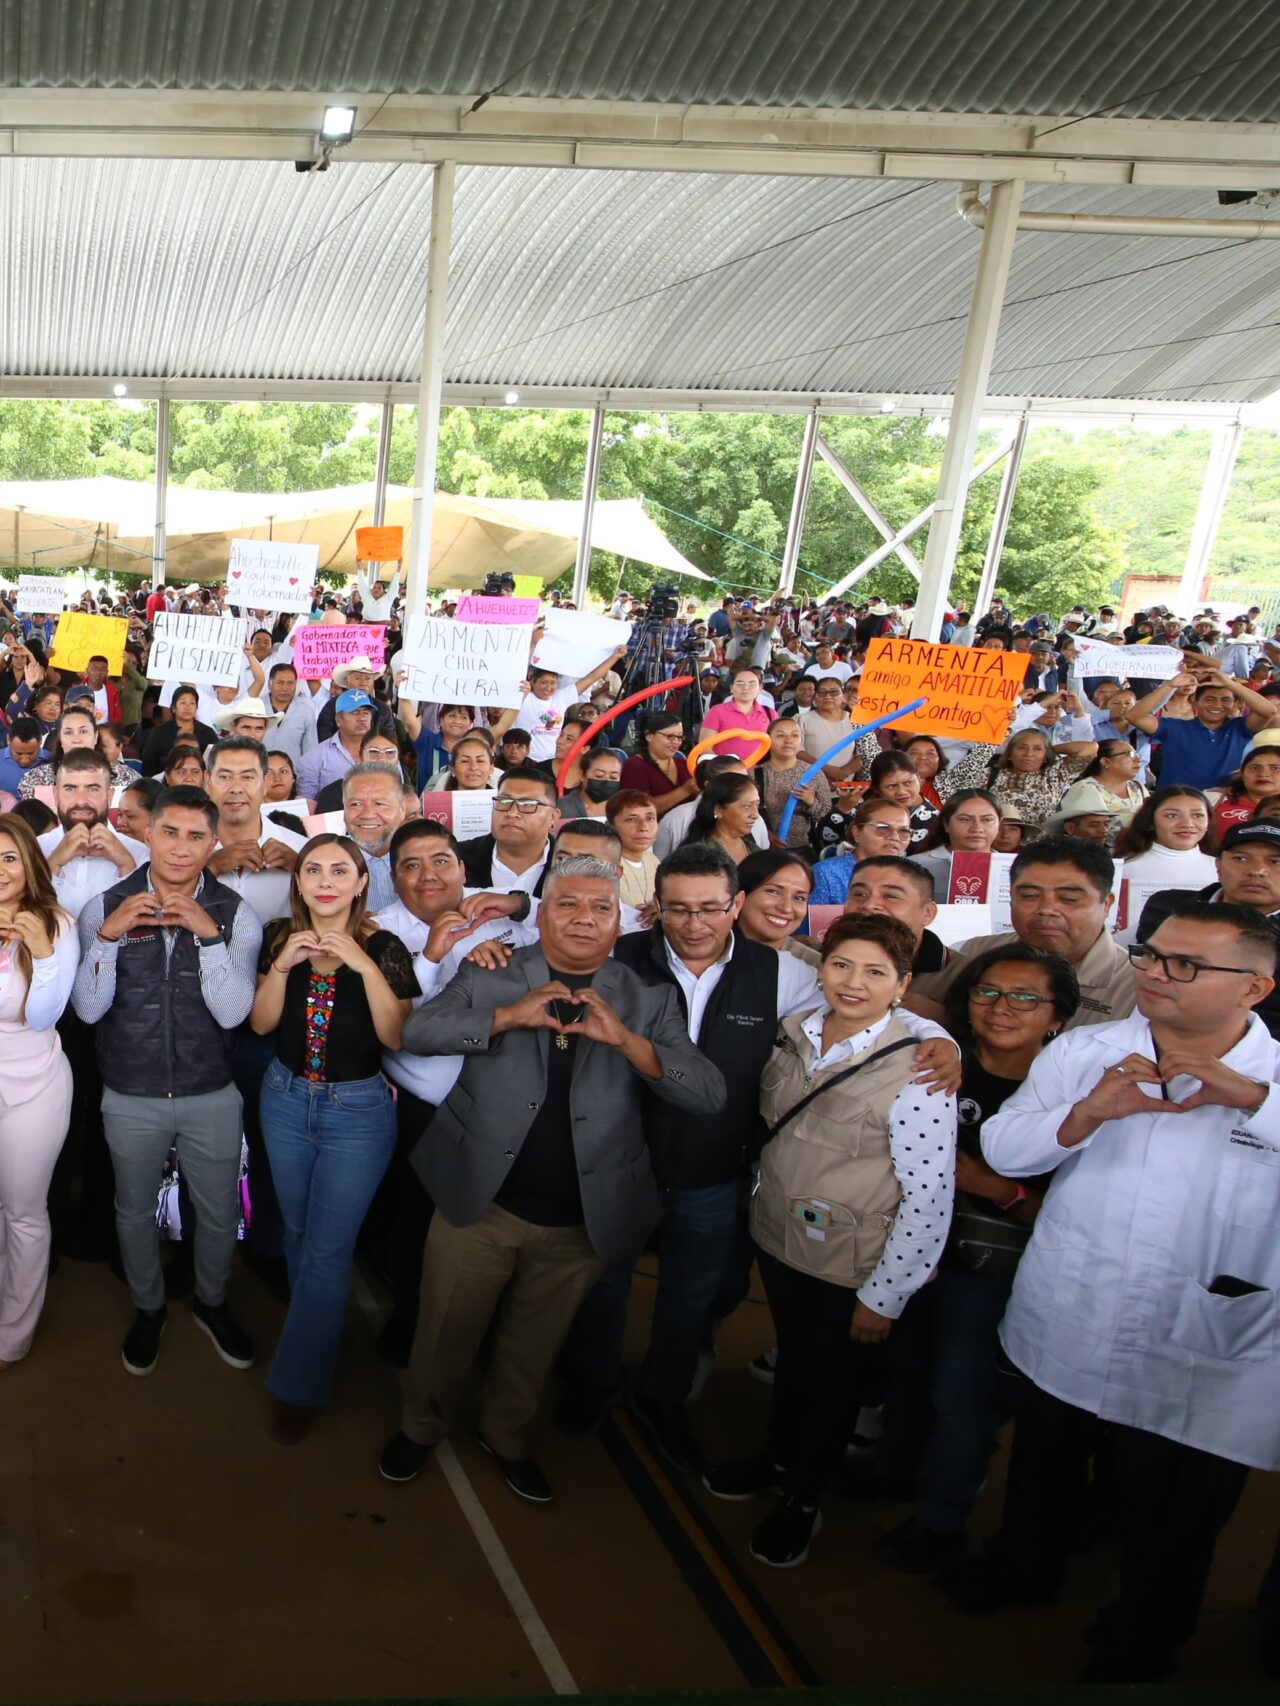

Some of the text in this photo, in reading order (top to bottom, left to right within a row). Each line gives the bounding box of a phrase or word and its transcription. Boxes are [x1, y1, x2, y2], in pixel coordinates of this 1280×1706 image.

[247, 582, 308, 602] Gobernador
[301, 628, 358, 641] Gobernador
[418, 620, 528, 654] ARMENTA
[301, 641, 380, 656] la MIXTECA que
[302, 655, 338, 667] trabaja
[444, 654, 488, 671] CHILA
[876, 641, 1004, 677] ARMENTA
[301, 667, 318, 676] con
[402, 662, 500, 696] TE ESPERA
[865, 669, 1020, 701] amigo AMATITLAN
[859, 694, 899, 714] esta
